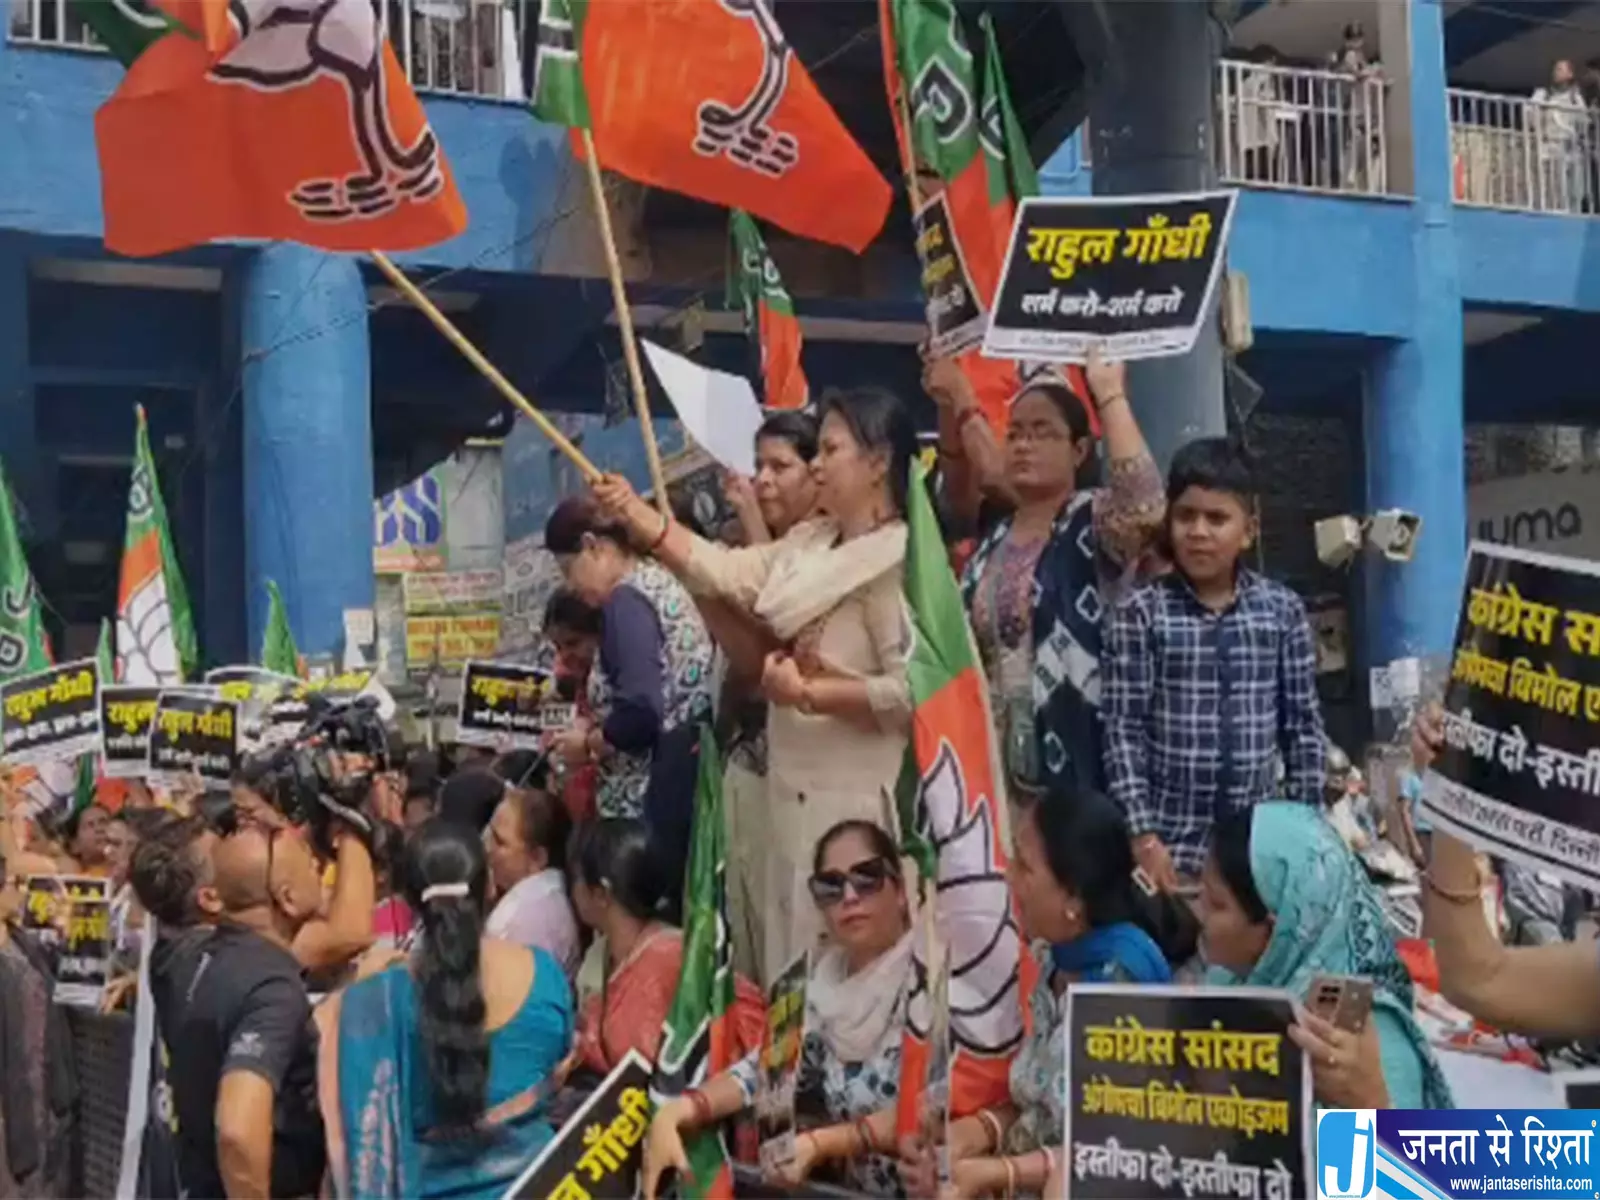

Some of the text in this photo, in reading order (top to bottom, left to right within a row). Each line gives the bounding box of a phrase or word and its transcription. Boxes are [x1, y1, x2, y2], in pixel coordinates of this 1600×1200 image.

[1027, 212, 1211, 279] राहुल गाँधी
[1143, 285, 1185, 315] करो
[1468, 582, 1559, 645] कांग्रेस
[1084, 1015, 1282, 1077] कांग्रेस सांसद
[576, 1087, 648, 1182] गाँधी
[1073, 1135, 1148, 1183] इस्तीफा
[1263, 1156, 1294, 1200] दो
